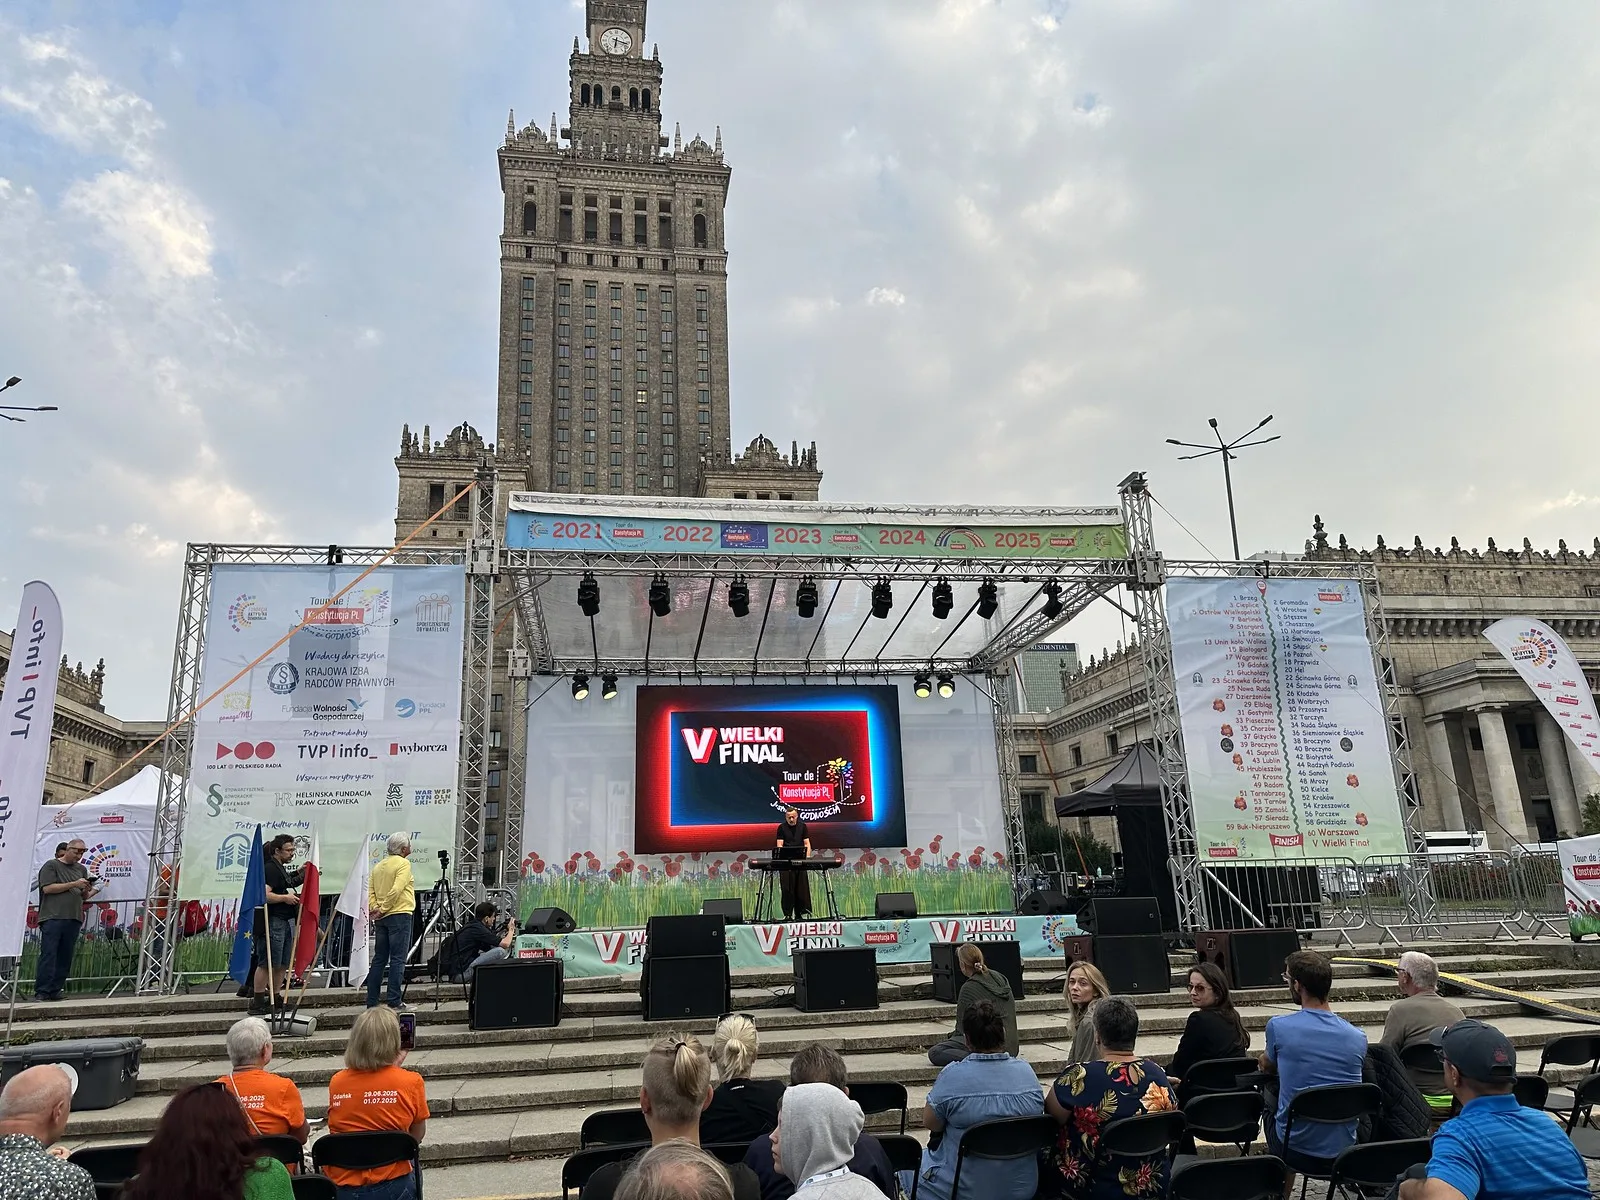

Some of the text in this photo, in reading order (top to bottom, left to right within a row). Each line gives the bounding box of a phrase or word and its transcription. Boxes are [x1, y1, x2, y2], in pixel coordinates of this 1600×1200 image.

[553, 522, 602, 539] 2021
[664, 526, 712, 542] 2022
[774, 528, 821, 544] 2023
[879, 530, 926, 545] 2024
[994, 533, 1041, 548] 2025
[310, 597, 330, 605] Tou
[351, 611, 359, 619] PL
[306, 667, 369, 676] KRAJOWA IZBA
[305, 678, 394, 688] RADCÓW PRAWNYCH
[313, 713, 364, 721] Gospodarczej
[298, 745, 328, 758] TVP
[400, 743, 447, 755] wyborcza
[681, 727, 784, 764] V WIELKI
[719, 743, 784, 764] FINAŁ
[782, 770, 814, 781] Tour de
[783, 786, 830, 799] Konstytucja PL
[410, 832, 421, 840] IT
[1275, 836, 1299, 845] FINISH
[930, 920, 960, 942] V
[962, 919, 1016, 932] WIELKI
[753, 925, 784, 955] V
[786, 922, 843, 936] WIELKI
[866, 934, 890, 942] Konstytucja
[592, 932, 625, 963] V
